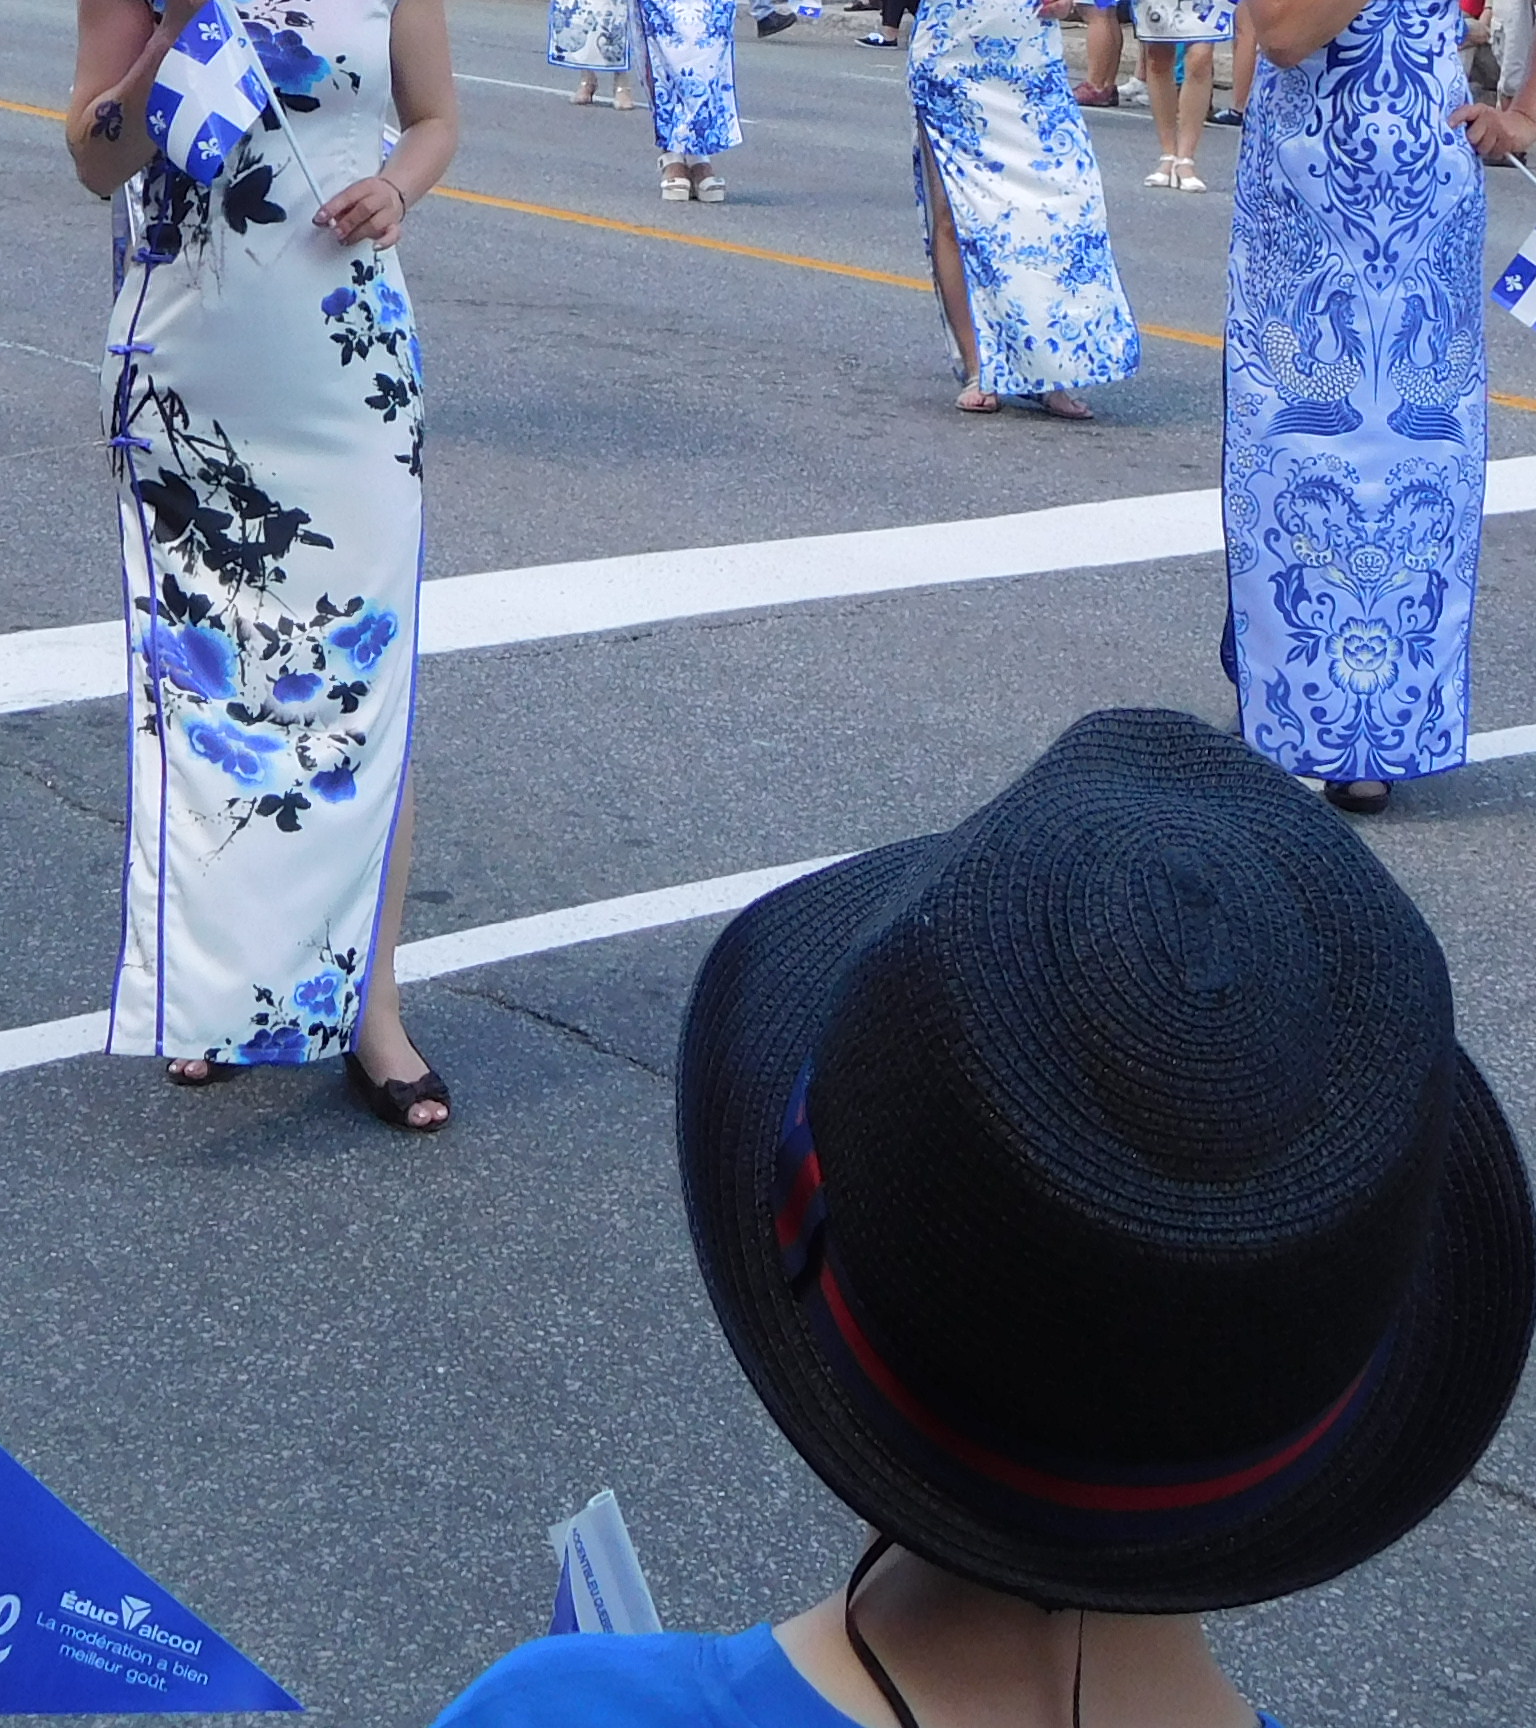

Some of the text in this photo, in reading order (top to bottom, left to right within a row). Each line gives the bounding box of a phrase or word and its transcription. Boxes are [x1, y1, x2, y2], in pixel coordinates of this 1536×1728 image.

[36, 1611, 57, 1631] La
[59, 1623, 153, 1666] modération
[172, 1661, 209, 1686] bien
[60, 1590, 203, 1655] Éduc alcool
[59, 1644, 122, 1673] meilleur
